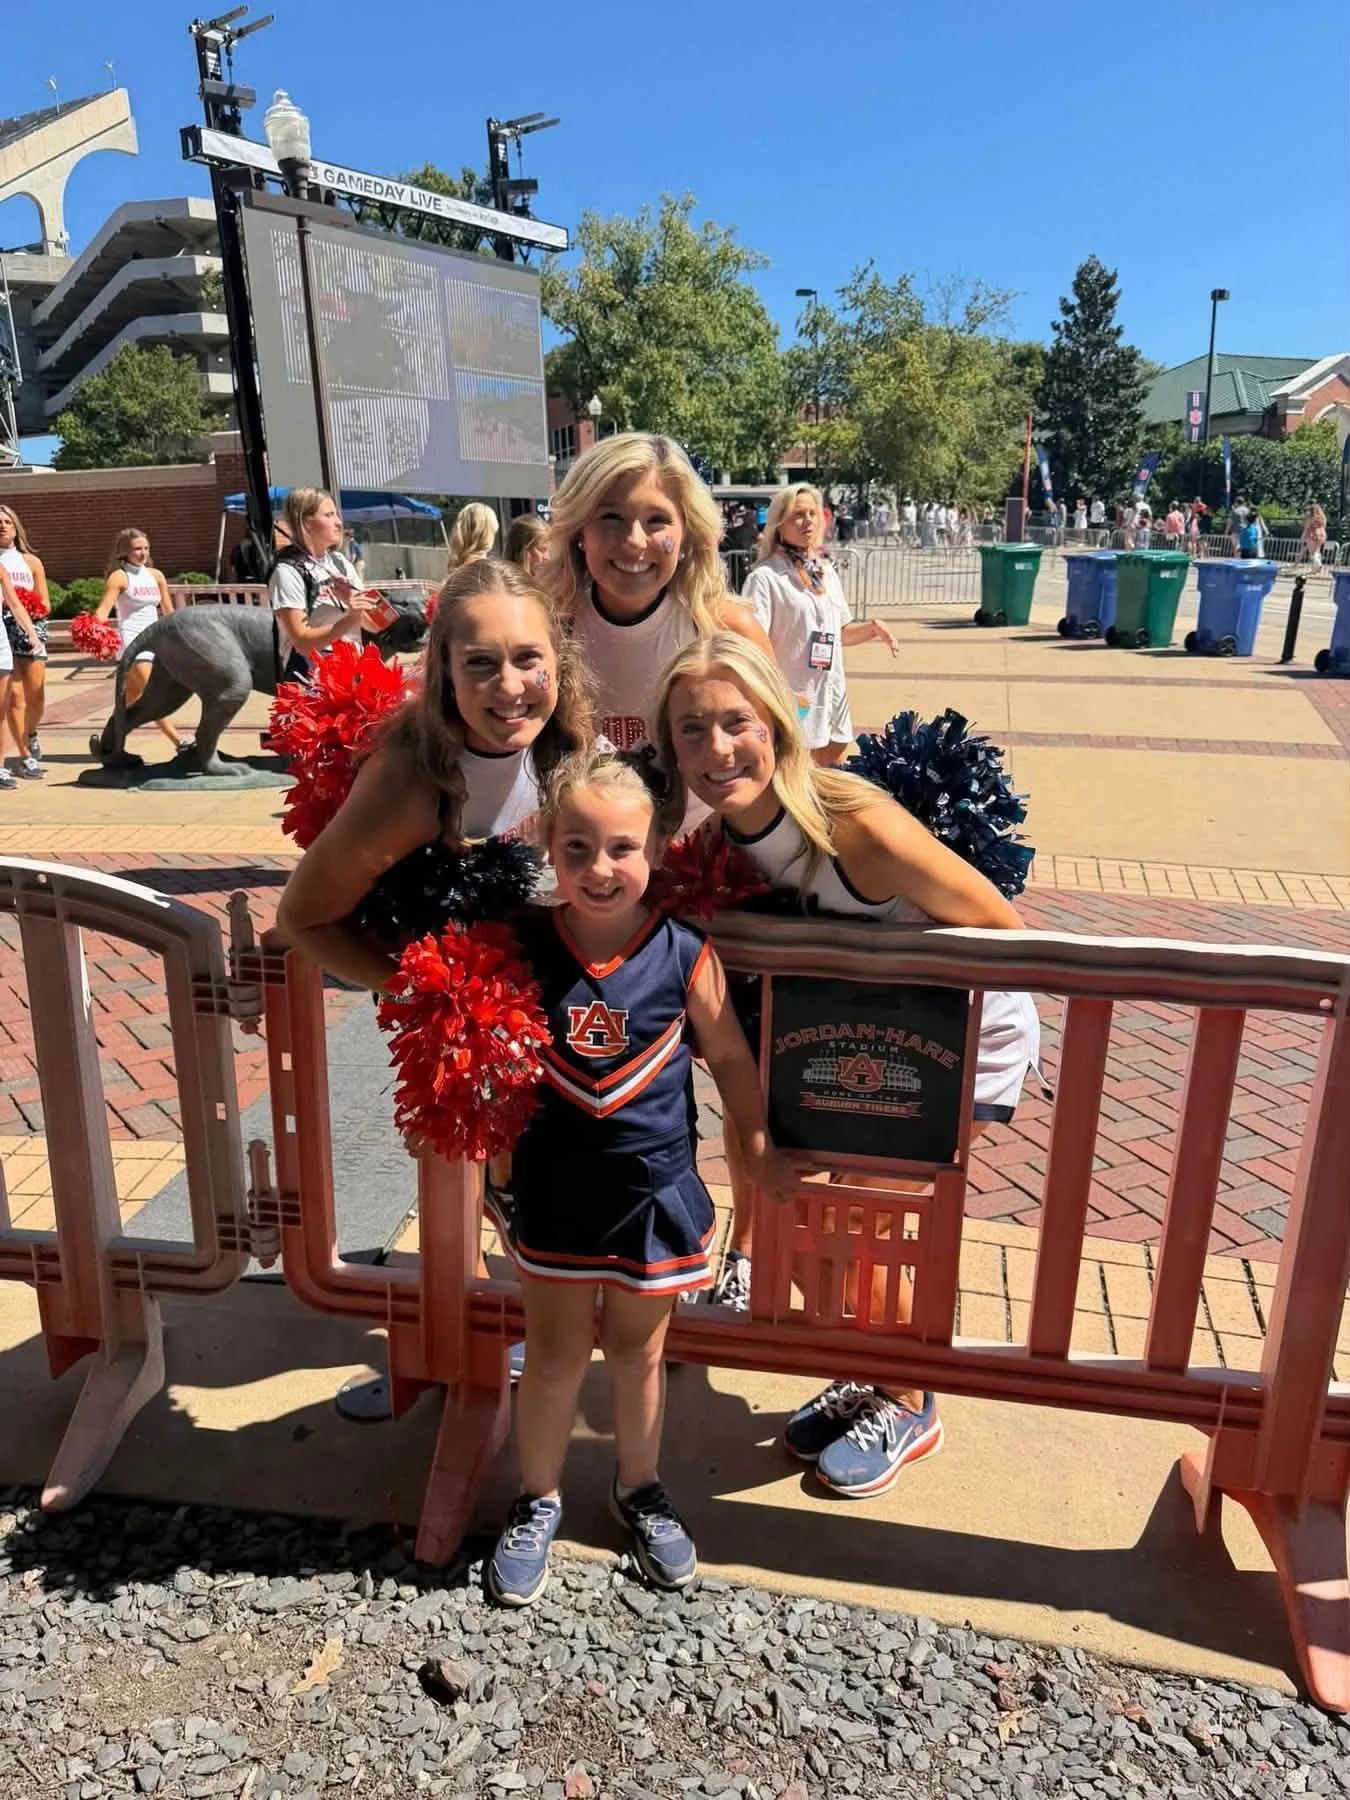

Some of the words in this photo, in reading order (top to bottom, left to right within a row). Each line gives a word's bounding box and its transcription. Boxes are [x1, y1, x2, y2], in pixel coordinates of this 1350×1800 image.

[324, 168, 405, 199] GAMEDAY
[410, 190, 442, 211] LIVE
[566, 1000, 629, 1057] AU
[775, 1023, 961, 1071] JORDAN-HARE
[828, 1041, 898, 1053] STADIUM
